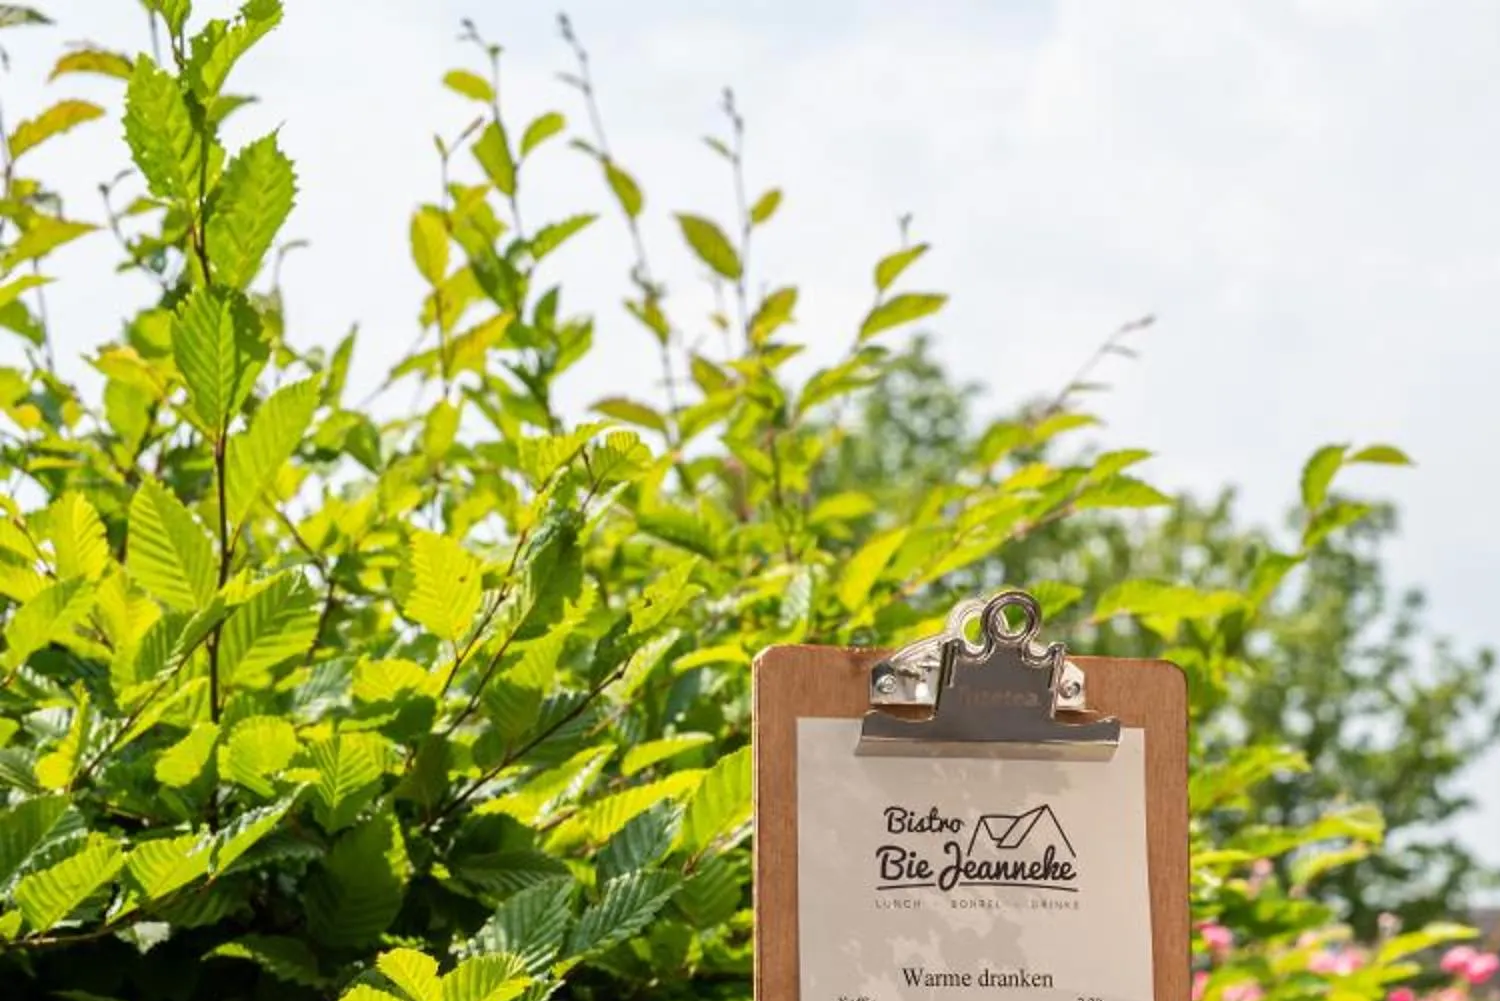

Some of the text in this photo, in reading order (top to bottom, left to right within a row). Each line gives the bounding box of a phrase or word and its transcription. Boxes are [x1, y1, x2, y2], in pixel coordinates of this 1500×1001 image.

[884, 806, 965, 834] Bistro
[875, 841, 1077, 891] Bie Jeanneke
[875, 900, 921, 909] LUNCH
[902, 968, 1053, 988] Warme dranken
